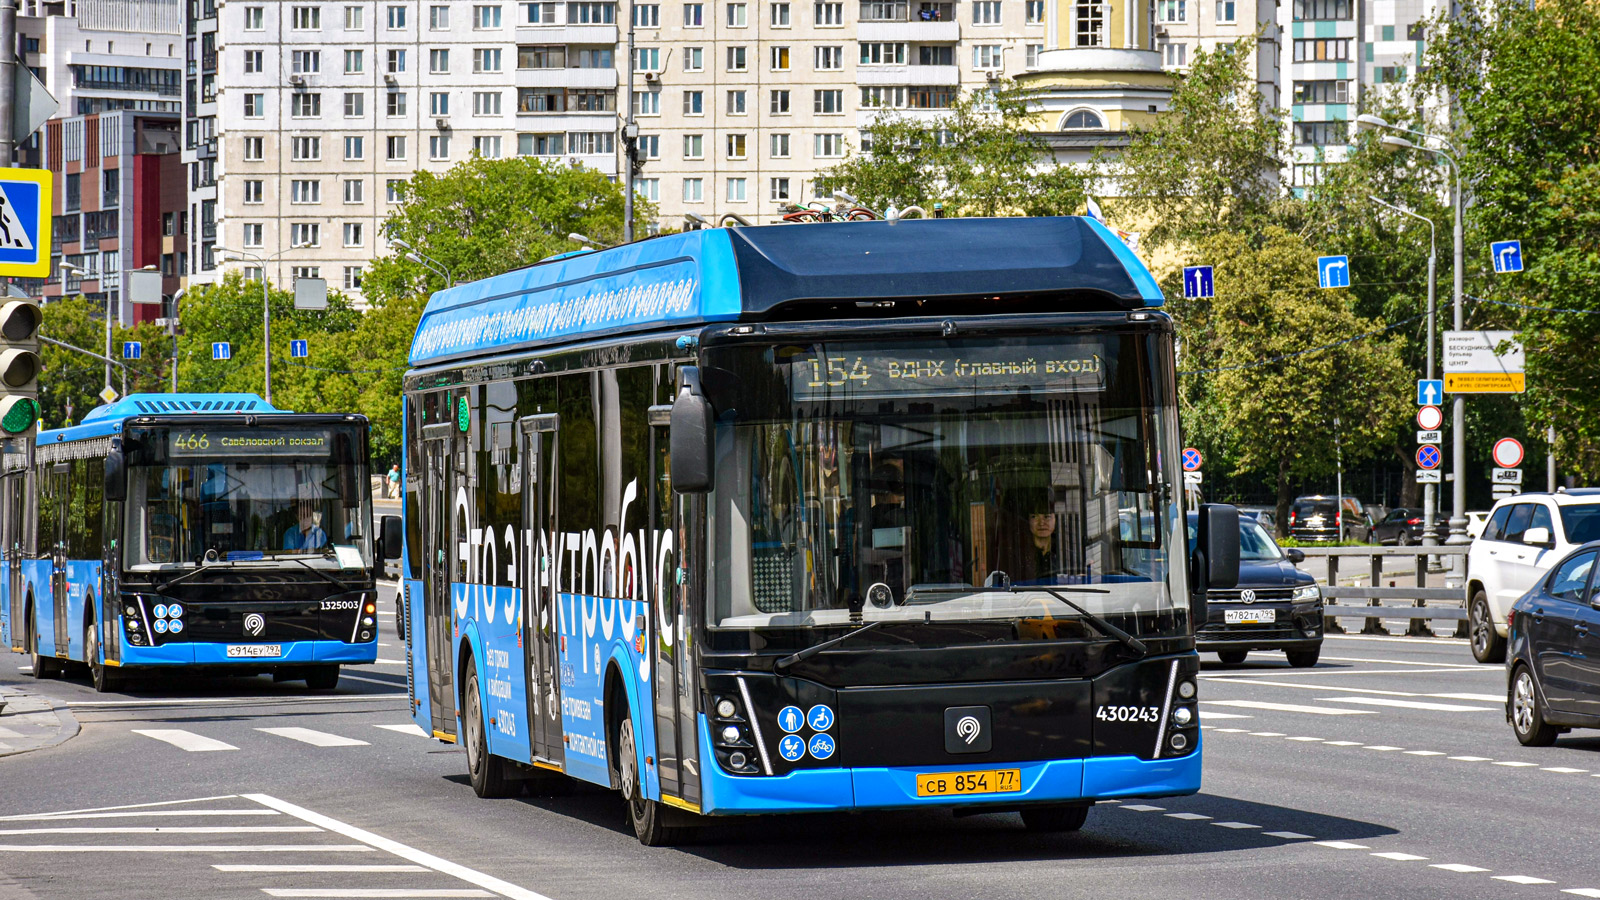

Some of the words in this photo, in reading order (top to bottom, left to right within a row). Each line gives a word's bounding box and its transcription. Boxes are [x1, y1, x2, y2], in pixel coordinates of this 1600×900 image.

[807, 357, 872, 387] 154
[888, 360, 946, 379] ВДНХ
[954, 357, 1037, 378] (главный
[1045, 353, 1100, 375] вход)
[174, 433, 210, 450] 466
[221, 436, 285, 447] Савёловский
[289, 437, 324, 446] вокзал
[320, 601, 359, 611] 1325003
[1227, 611, 1260, 620] М782ТА
[230, 646, 264, 656] С914ЕУ
[1096, 706, 1159, 722] 430243
[497, 709, 516, 737] 430243
[597, 739, 606, 760] сет
[926, 780, 947, 793] СВ
[955, 773, 987, 791] 854
[997, 771, 1014, 785] 77
